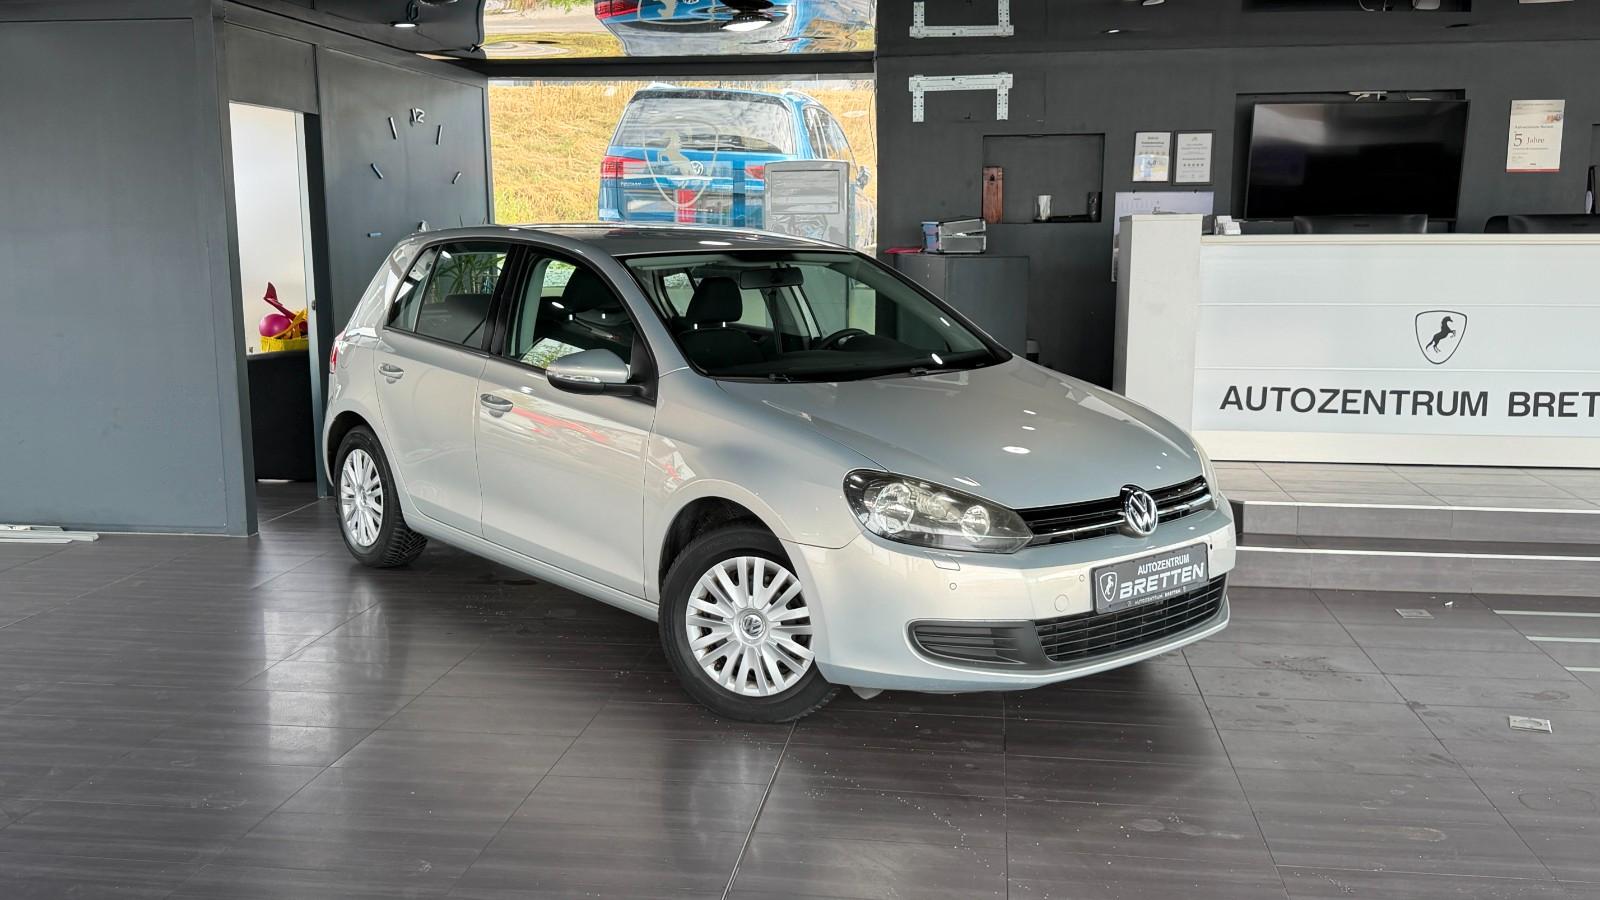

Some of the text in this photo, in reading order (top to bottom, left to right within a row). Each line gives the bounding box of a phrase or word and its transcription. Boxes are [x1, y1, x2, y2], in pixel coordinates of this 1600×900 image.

[1513, 133, 1545, 147] 5 Jahre
[1219, 385, 1600, 417] AUTOZENTRUM BRET
[1137, 554, 1190, 576] AUTOZENTRUM
[1119, 562, 1205, 600] BRETTEN
